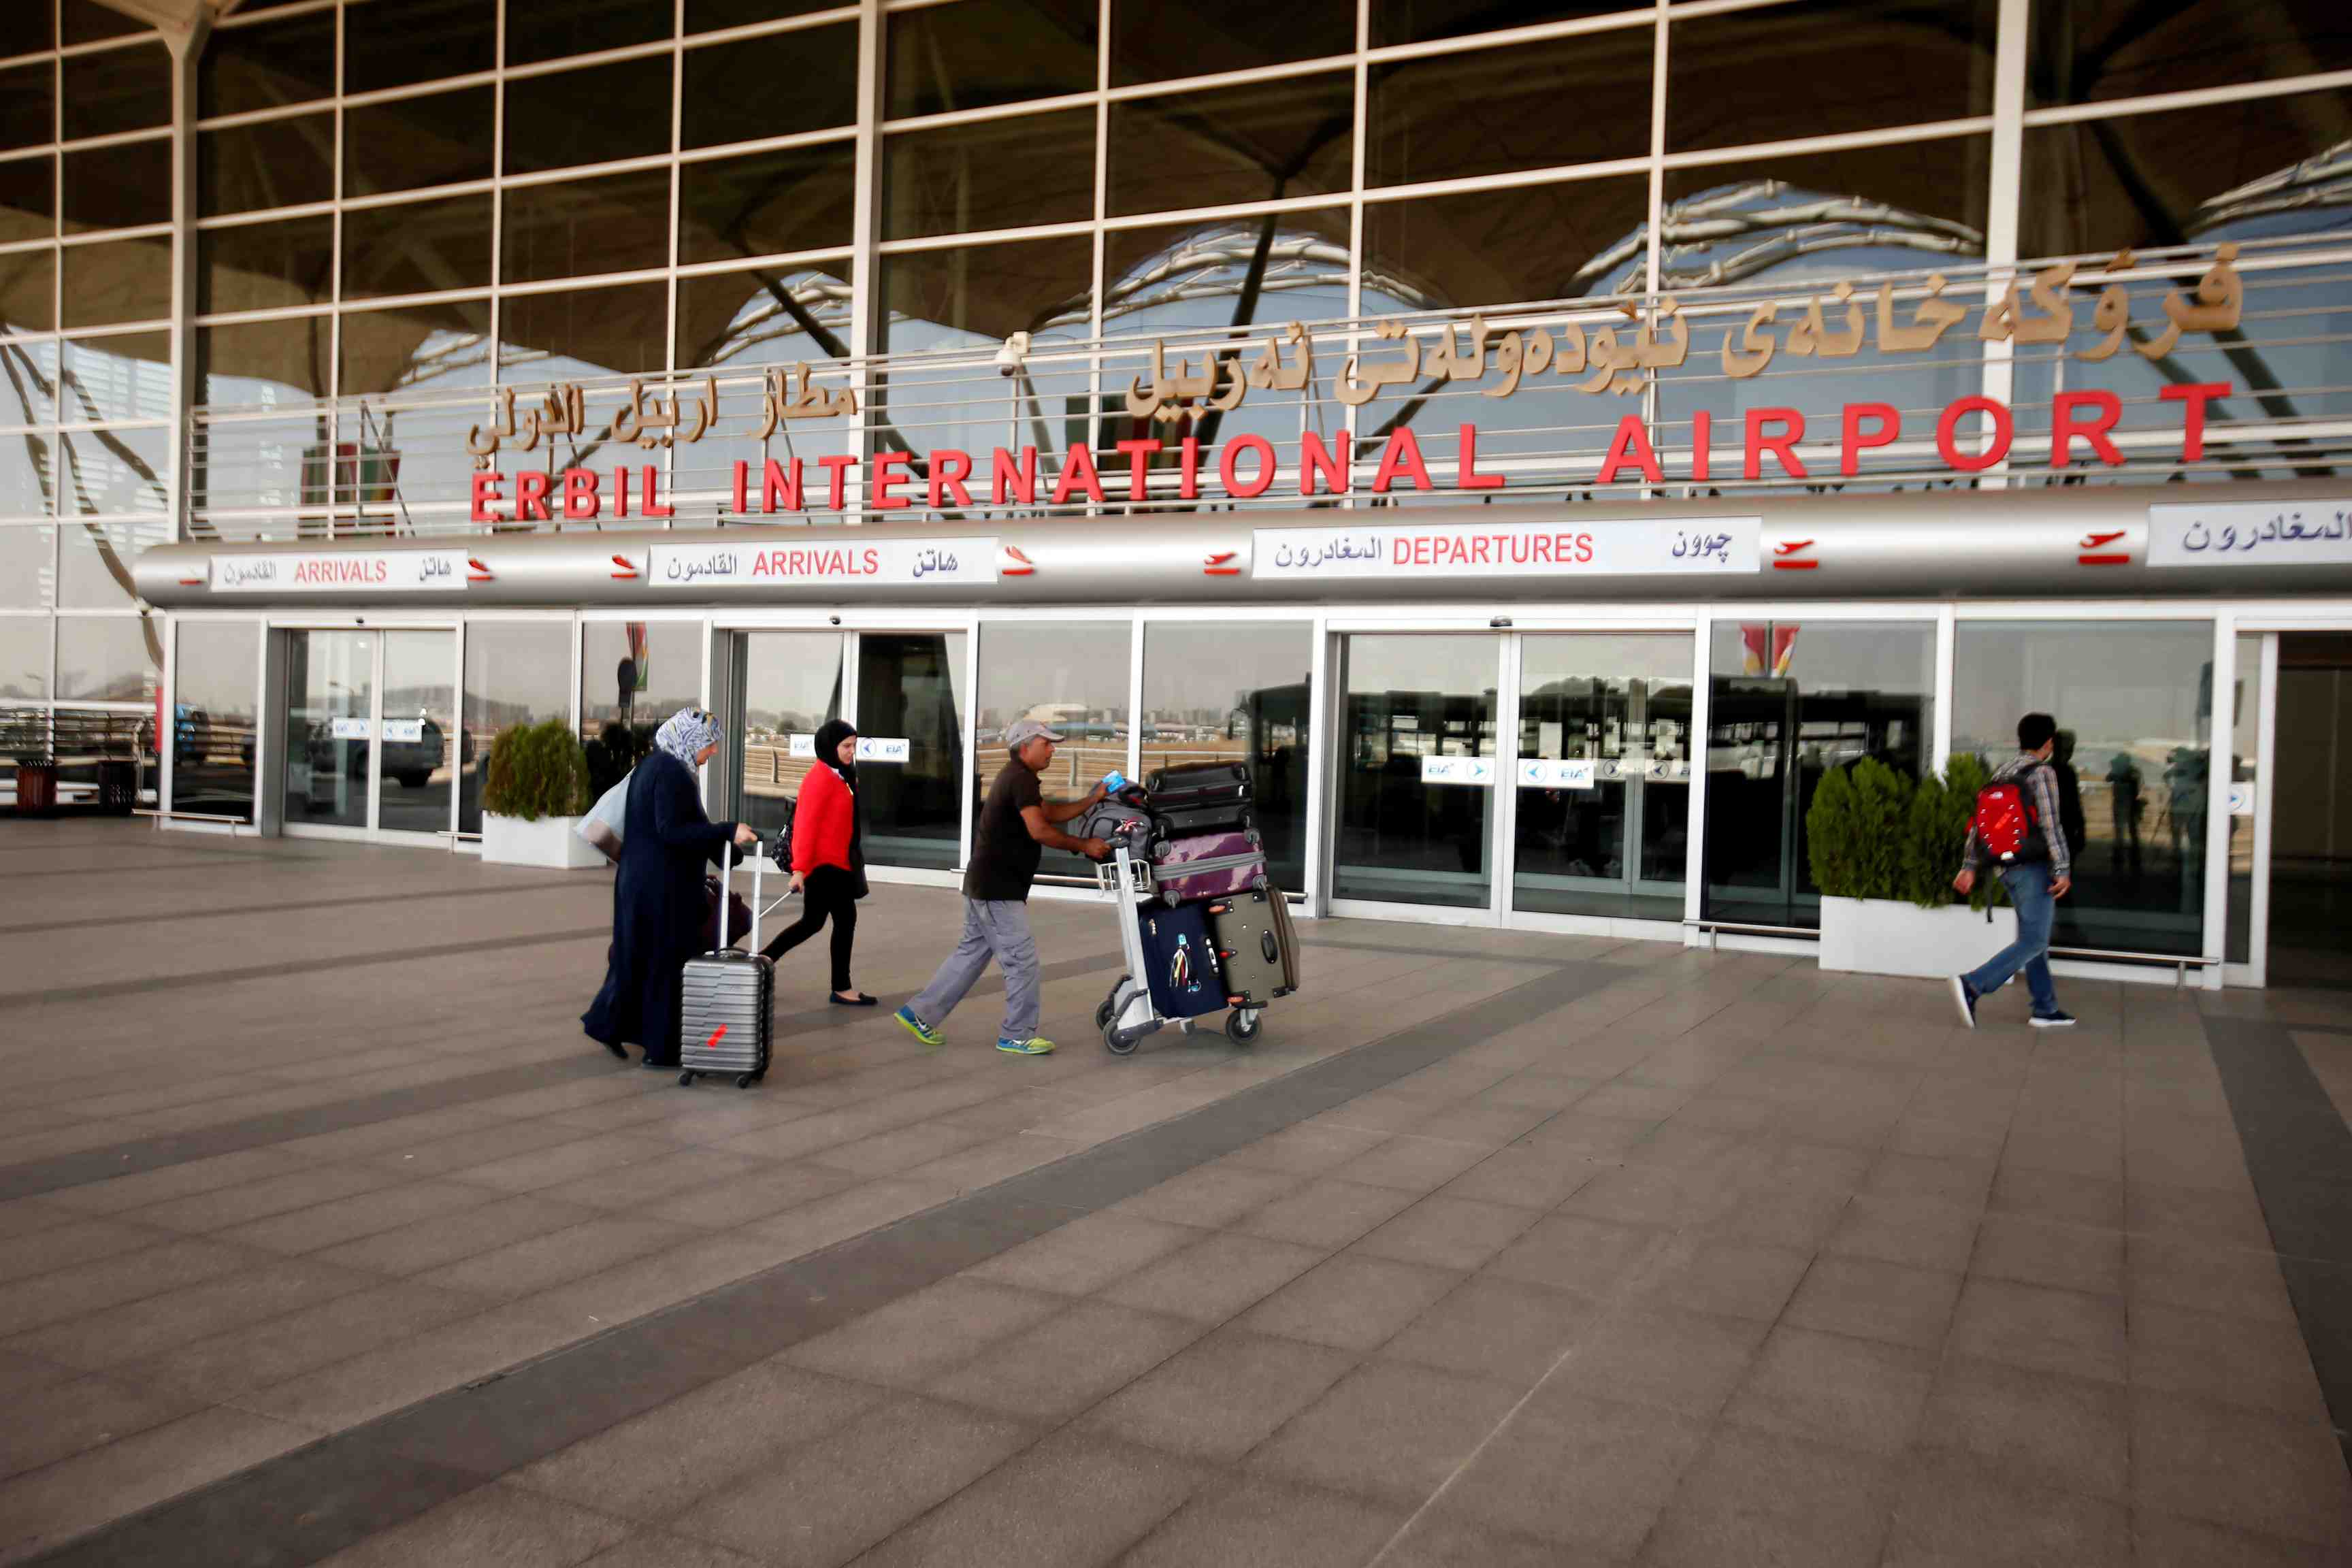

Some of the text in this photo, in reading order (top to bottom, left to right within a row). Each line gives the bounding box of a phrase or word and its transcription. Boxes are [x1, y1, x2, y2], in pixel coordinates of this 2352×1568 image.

[612, 375, 718, 450] اربيل
[749, 361, 858, 440] مطار
[471, 382, 2233, 523] ERBIL INTERNATIONAL AIRPORT
[752, 547, 879, 577] ARRIVALS
[1275, 536, 1382, 567] المغادرون
[1393, 533, 1594, 566] DEPARTURES
[1672, 529, 1732, 564] چوون
[295, 559, 387, 584] ARRIVALS
[667, 552, 737, 581] القادمون
[913, 549, 959, 577] هاتن
